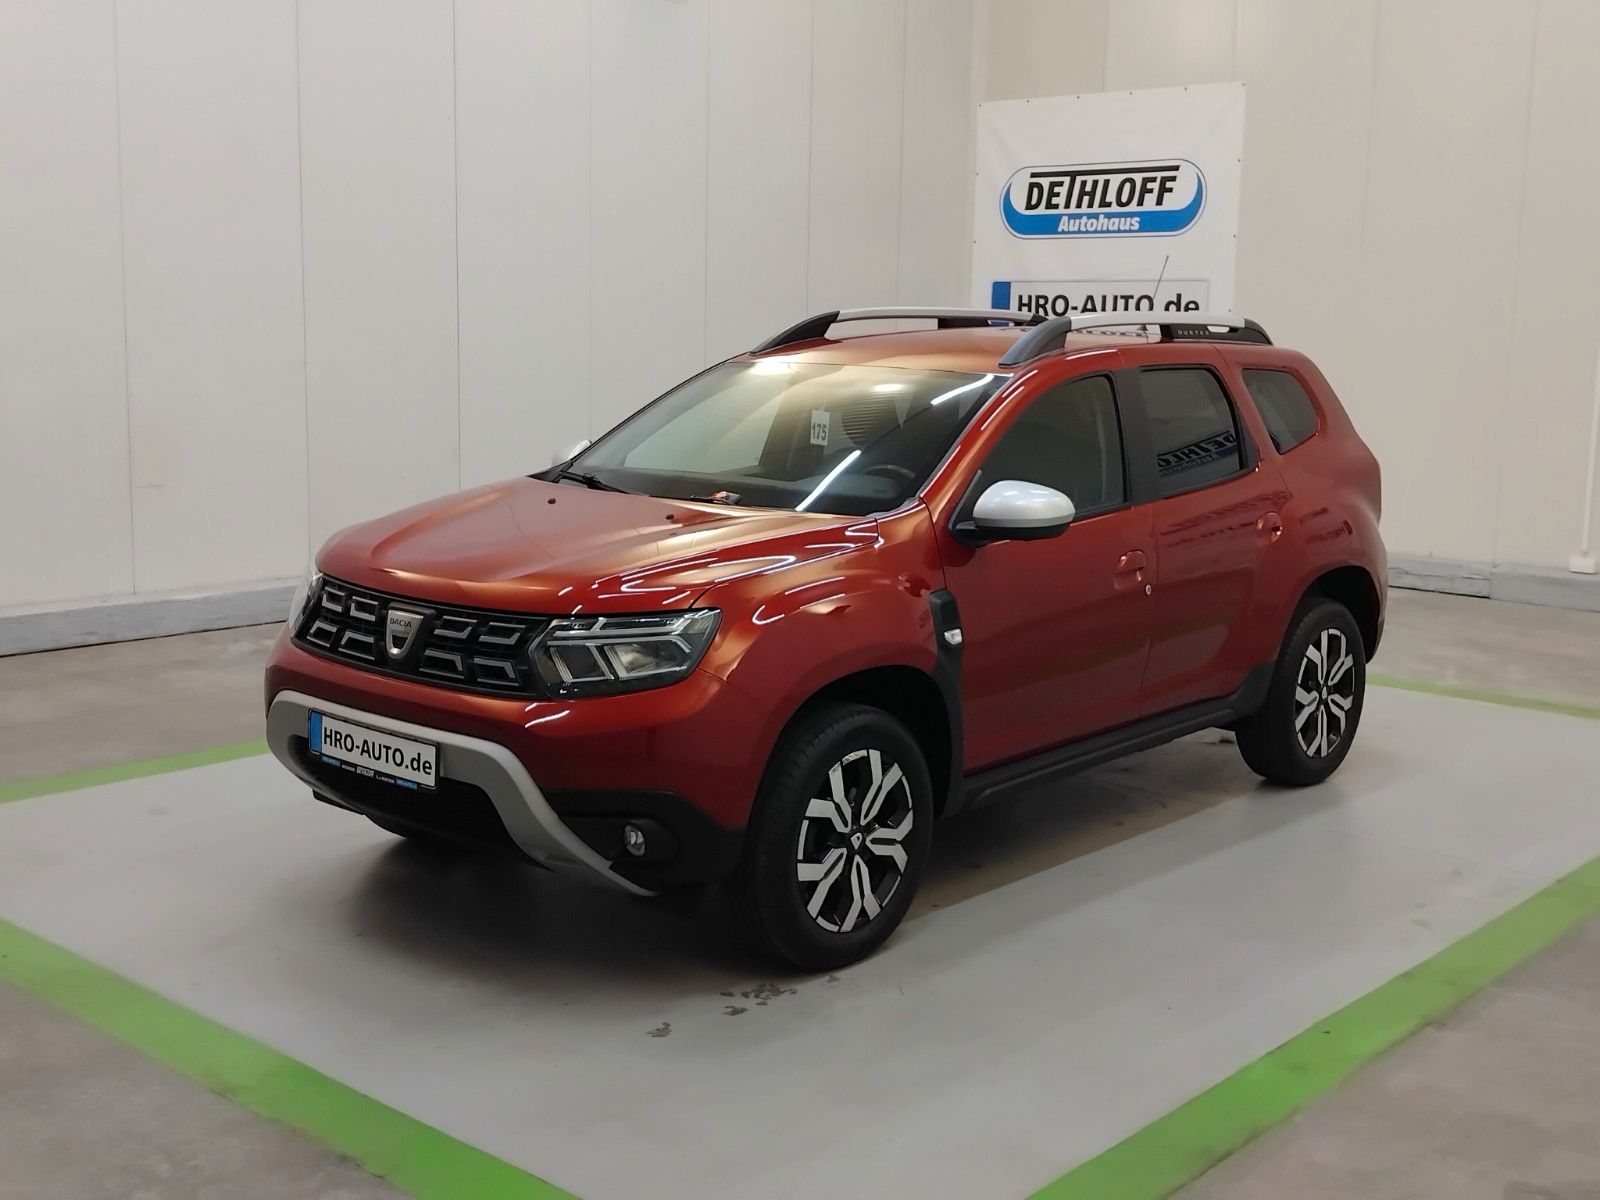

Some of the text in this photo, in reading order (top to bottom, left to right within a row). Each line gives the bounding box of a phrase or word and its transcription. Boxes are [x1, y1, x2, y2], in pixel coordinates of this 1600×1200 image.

[1024, 165, 1181, 211] DETHLOFF
[1057, 213, 1140, 232] Autohaus
[1017, 293, 1200, 317] HRO-AUTOde
[812, 422, 827, 441] 175
[389, 616, 412, 628] DACIA
[323, 726, 433, 776] HRO-AUTO.de
